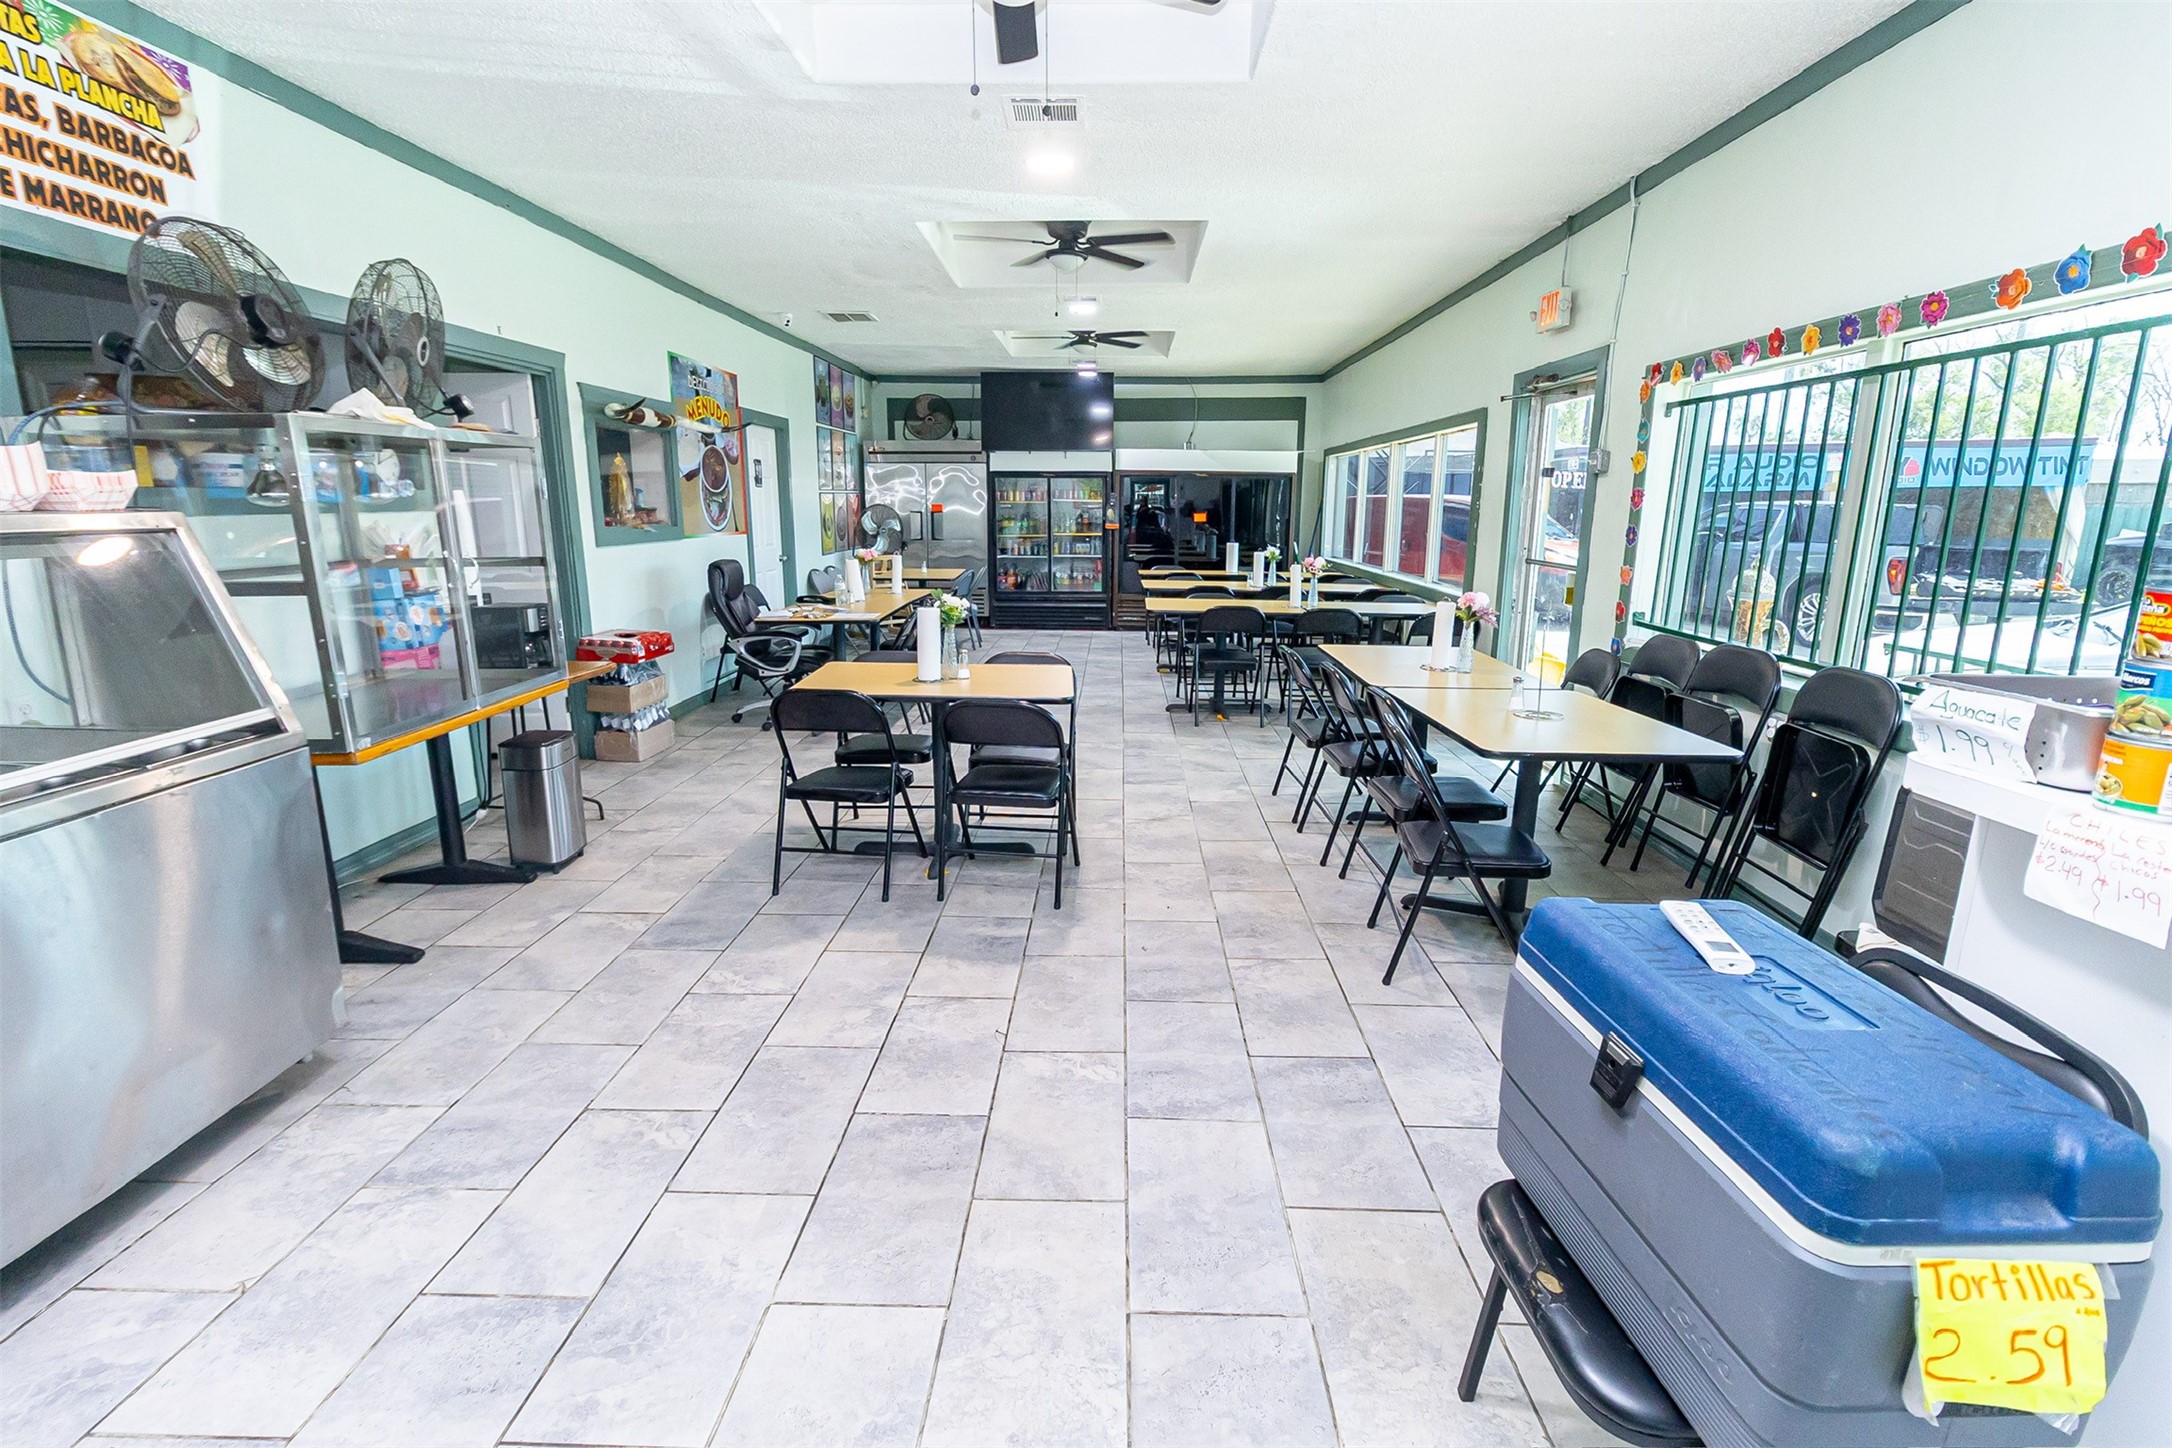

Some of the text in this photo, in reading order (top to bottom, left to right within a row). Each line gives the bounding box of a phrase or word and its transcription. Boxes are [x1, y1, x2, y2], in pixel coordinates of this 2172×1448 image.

[17, 46, 58, 90] LA
[56, 62, 165, 133] PLANCHA
[0, 83, 196, 180] AS, BARBACOA
[0, 125, 168, 206] HICHARRON
[1538, 289, 1560, 327] EXIT
[685, 395, 730, 428] MENUDO
[1704, 472, 1810, 488] ALARM
[2038, 456, 2090, 475] TINT
[1927, 690, 2021, 731] Aguacate
[2068, 813, 2167, 856] CHILES
[1919, 1260, 2096, 1302] Tortillas
